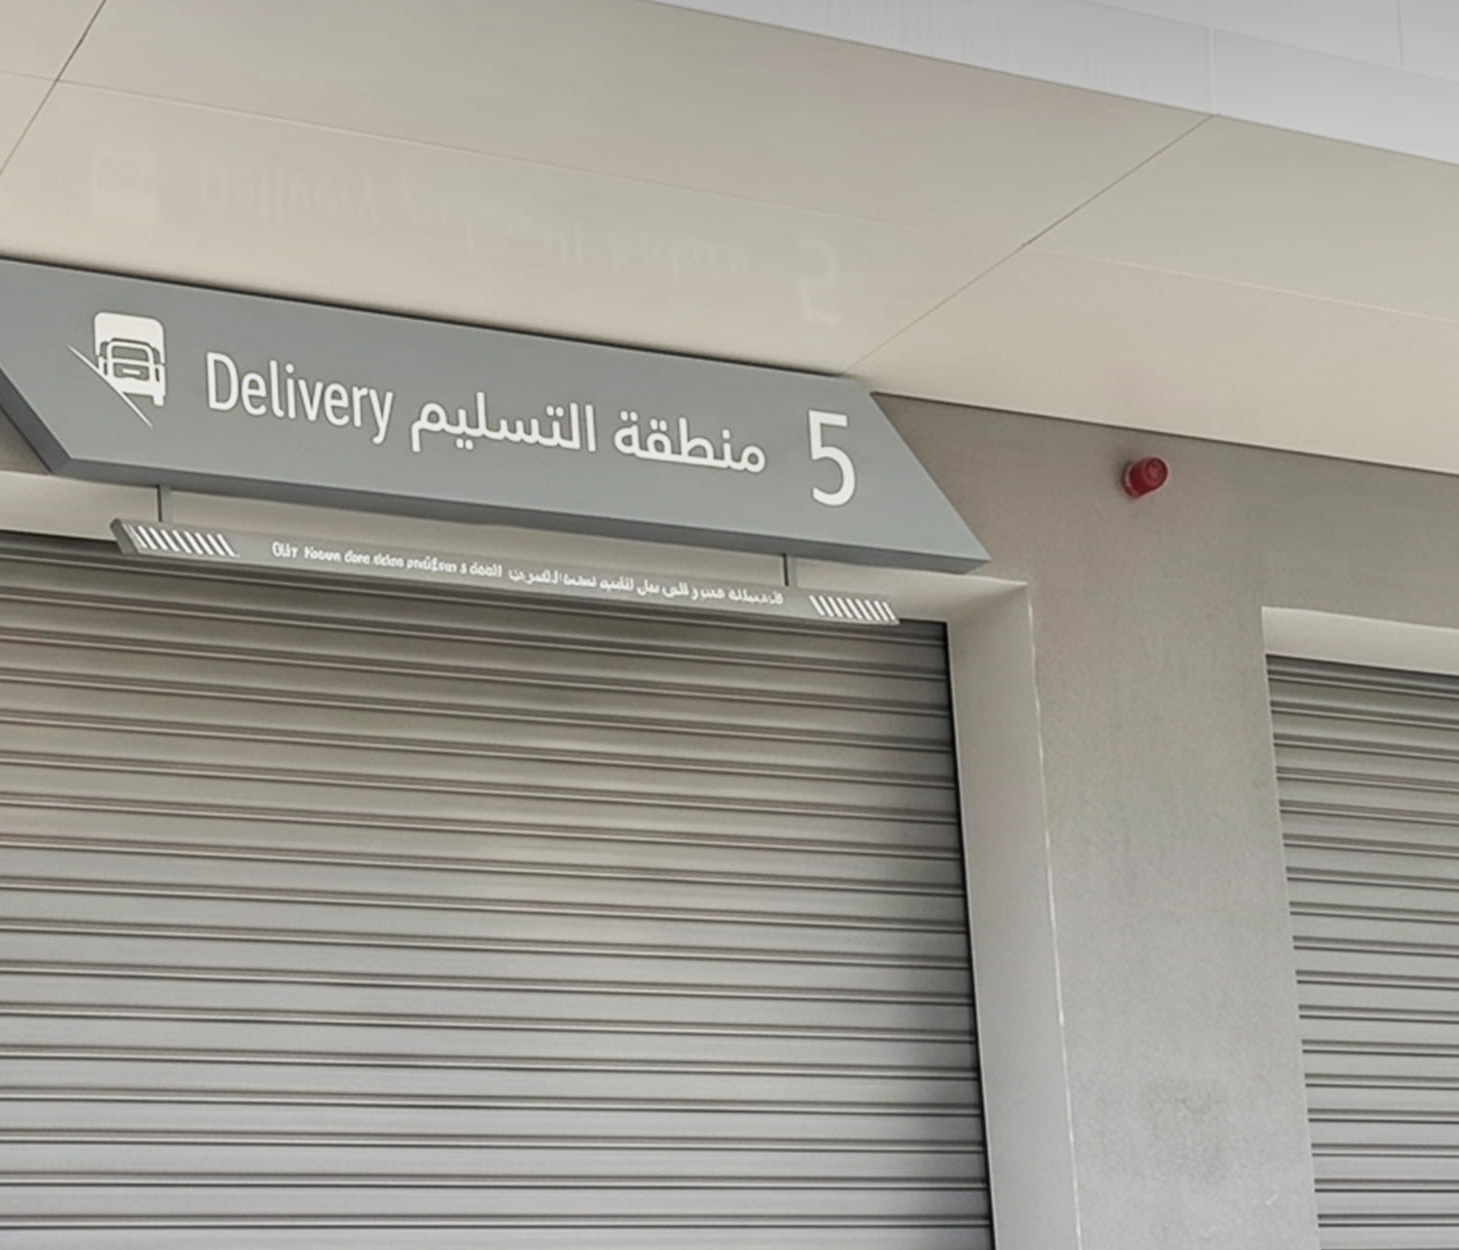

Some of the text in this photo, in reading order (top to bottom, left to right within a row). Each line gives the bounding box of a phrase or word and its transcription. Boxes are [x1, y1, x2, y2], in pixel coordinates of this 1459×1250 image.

[205, 351, 394, 445] Delivery
[410, 390, 767, 475] منطقة التسليم
[807, 409, 857, 507] 5
